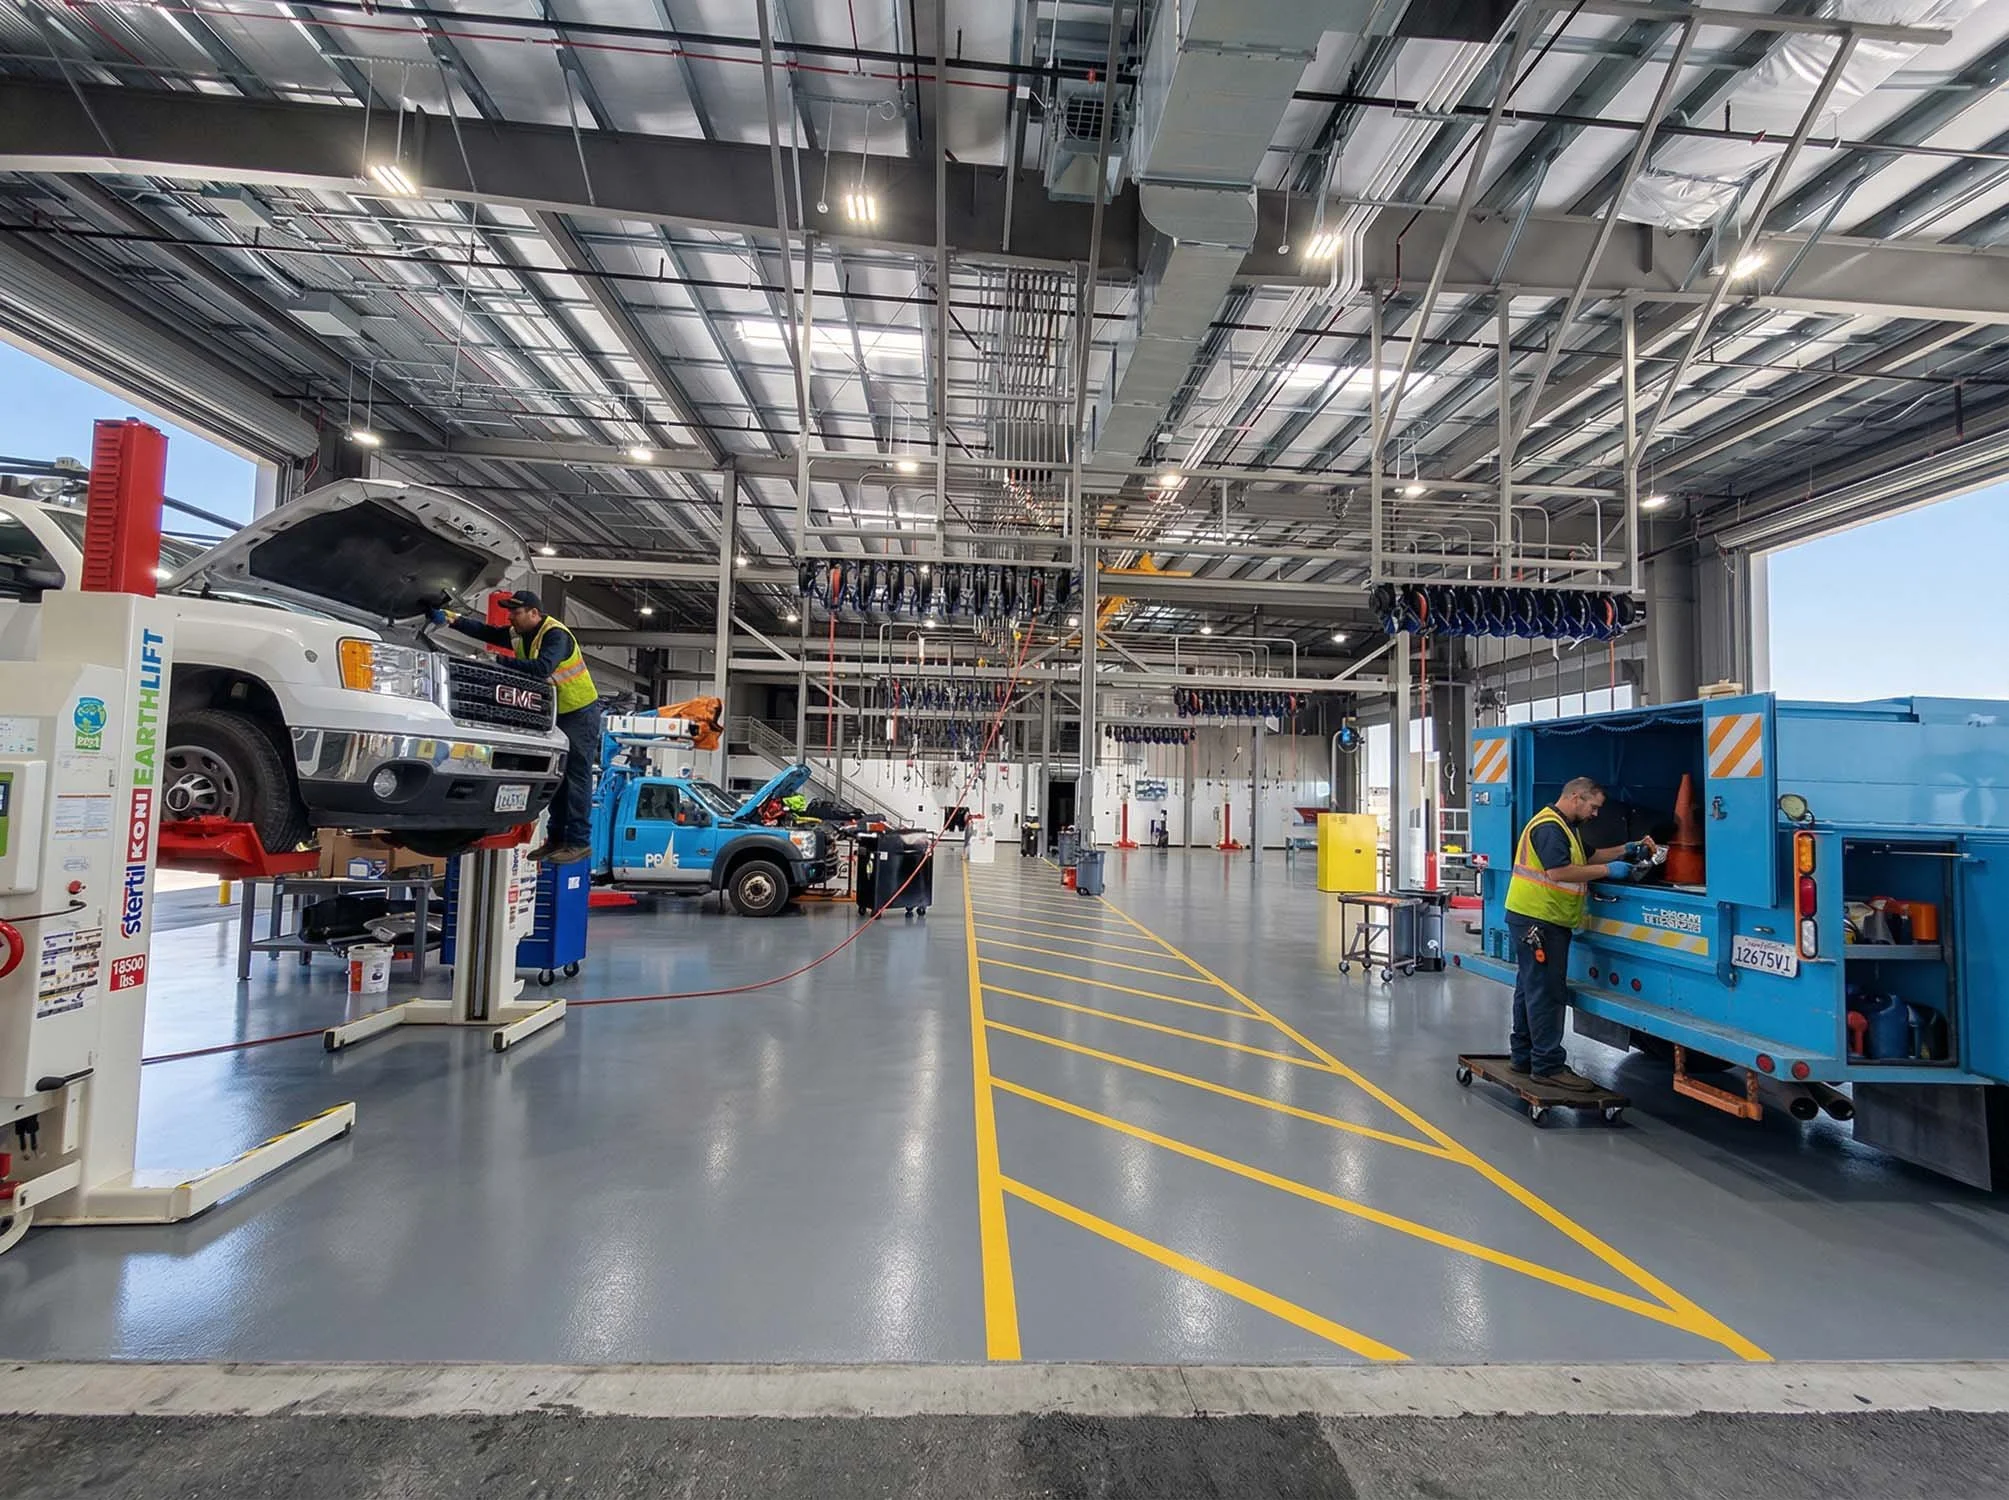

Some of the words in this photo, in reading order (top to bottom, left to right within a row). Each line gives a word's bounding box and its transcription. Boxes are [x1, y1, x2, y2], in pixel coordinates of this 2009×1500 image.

[133, 628, 164, 785] EARTHLIFT
[495, 684, 542, 712] GMC
[131, 793, 149, 859] KONI
[121, 864, 146, 938] stertil
[112, 956, 144, 976] 18500
